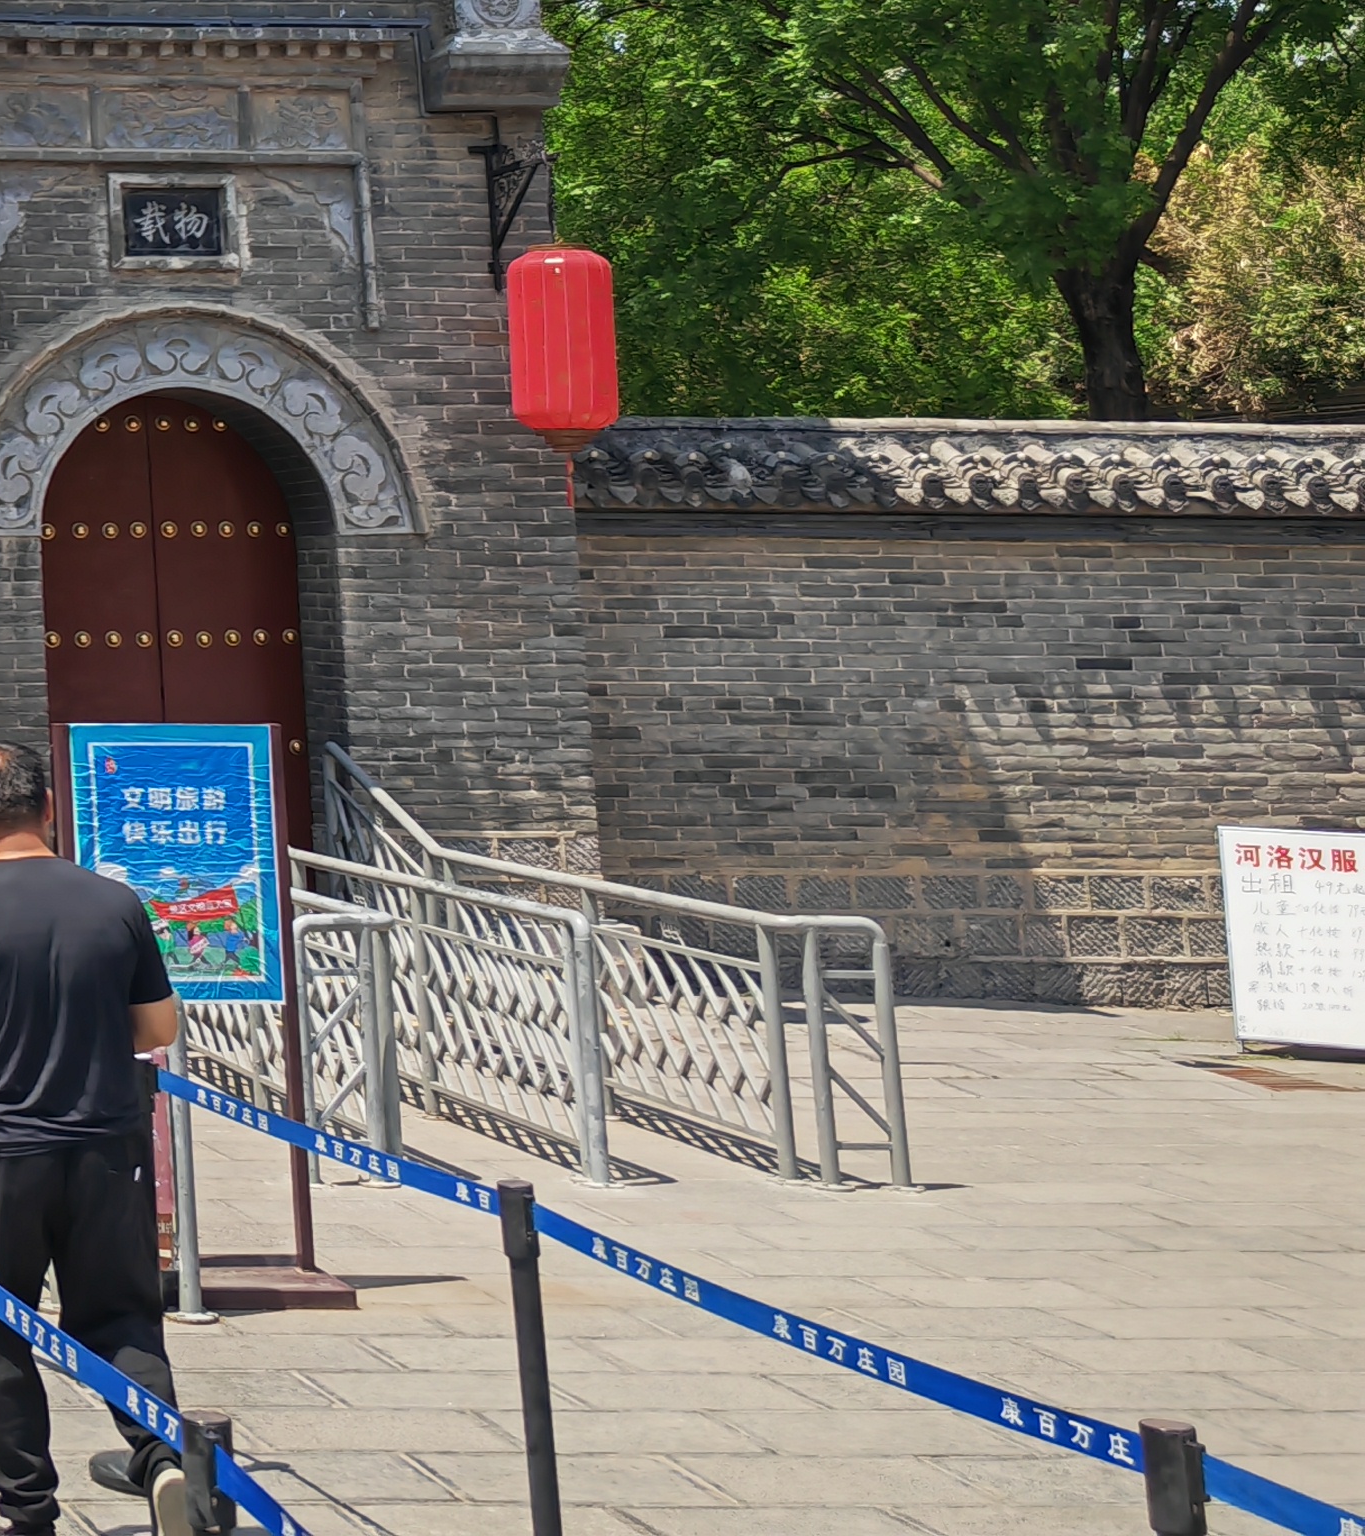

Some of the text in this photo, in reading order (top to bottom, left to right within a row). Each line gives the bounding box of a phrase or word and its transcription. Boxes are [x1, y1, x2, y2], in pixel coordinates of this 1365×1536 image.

[121, 786, 226, 811] 文明旅游
[122, 819, 228, 845] 快乐出行
[1235, 843, 1359, 872] 河洛汉服
[1241, 872, 1296, 895] 出租
[196, 1088, 268, 1132] 康百万庄园
[314, 1134, 401, 1180] 康百万庄园
[455, 1182, 491, 1210] 康百
[592, 1237, 700, 1303] 康百万庄园
[5, 1298, 78, 1373] 康百万庄园
[772, 1313, 907, 1386] 康百万庄园
[126, 1385, 180, 1442] 康百万
[1000, 1396, 1135, 1465] 康百万庄
